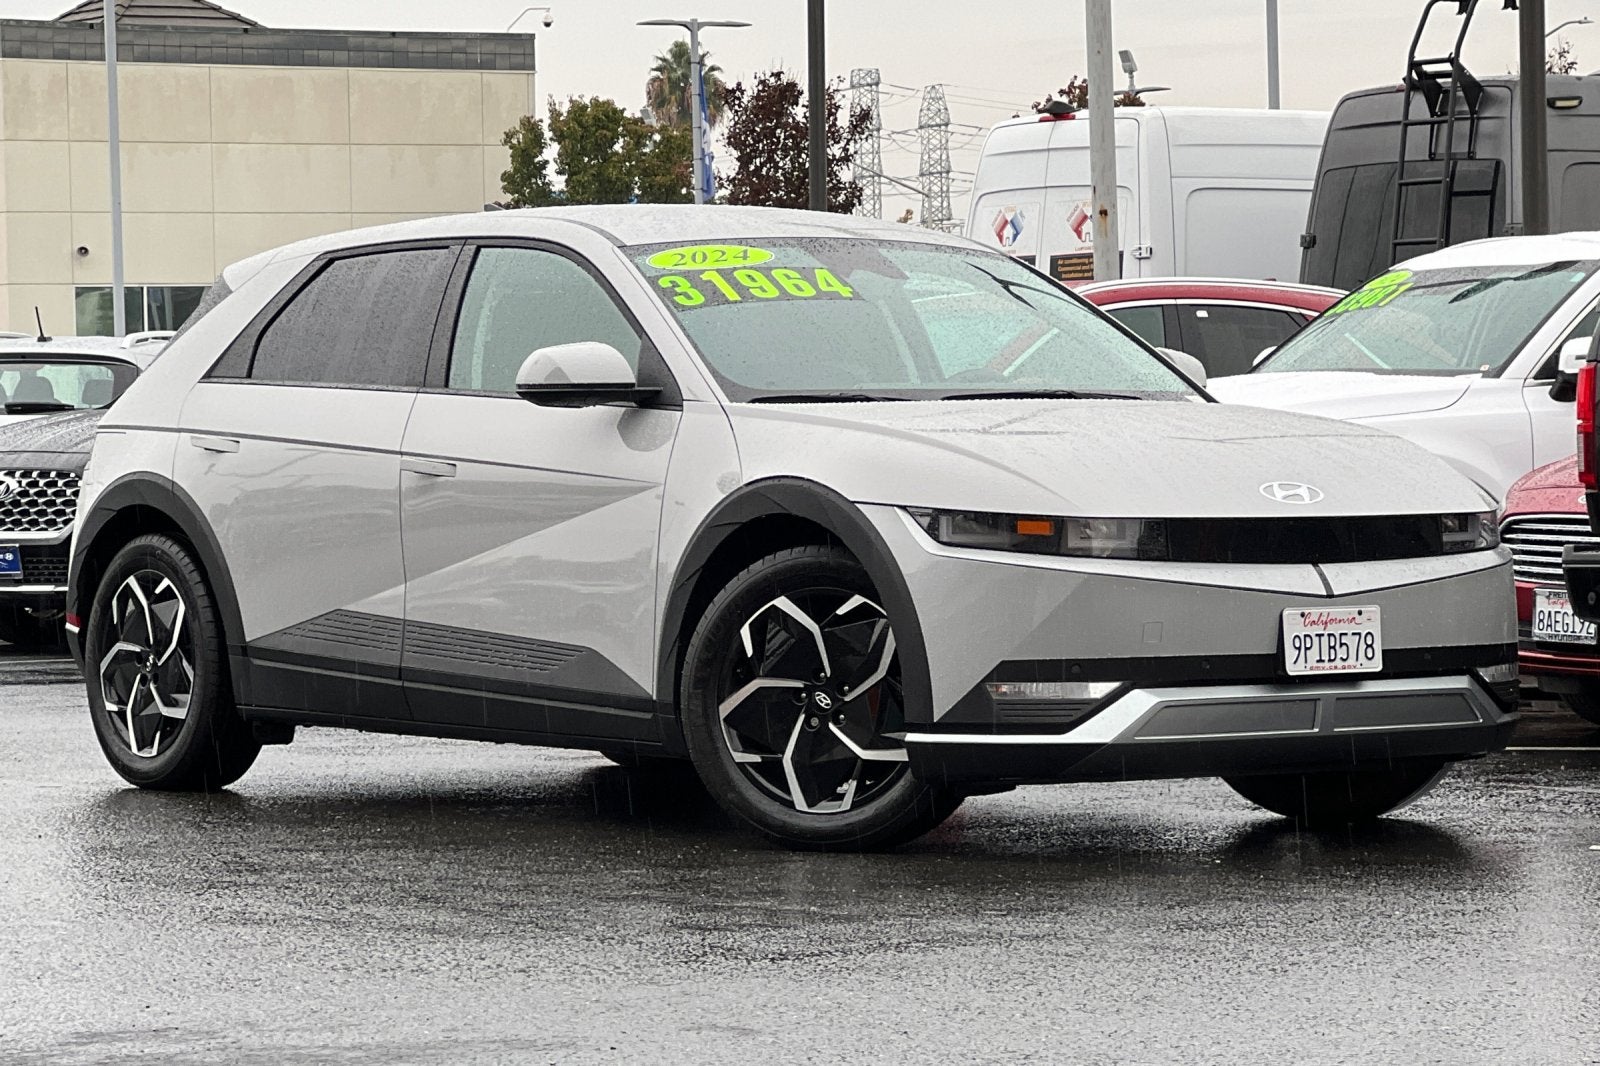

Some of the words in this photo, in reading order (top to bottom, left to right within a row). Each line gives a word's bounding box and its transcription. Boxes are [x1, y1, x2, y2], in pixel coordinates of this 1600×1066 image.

[670, 248, 750, 267] 2024
[658, 268, 853, 306] 31964
[1302, 611, 1362, 631] California
[1292, 631, 1375, 665] 9PIB578
[1309, 663, 1358, 671] dmv.ca.gov
